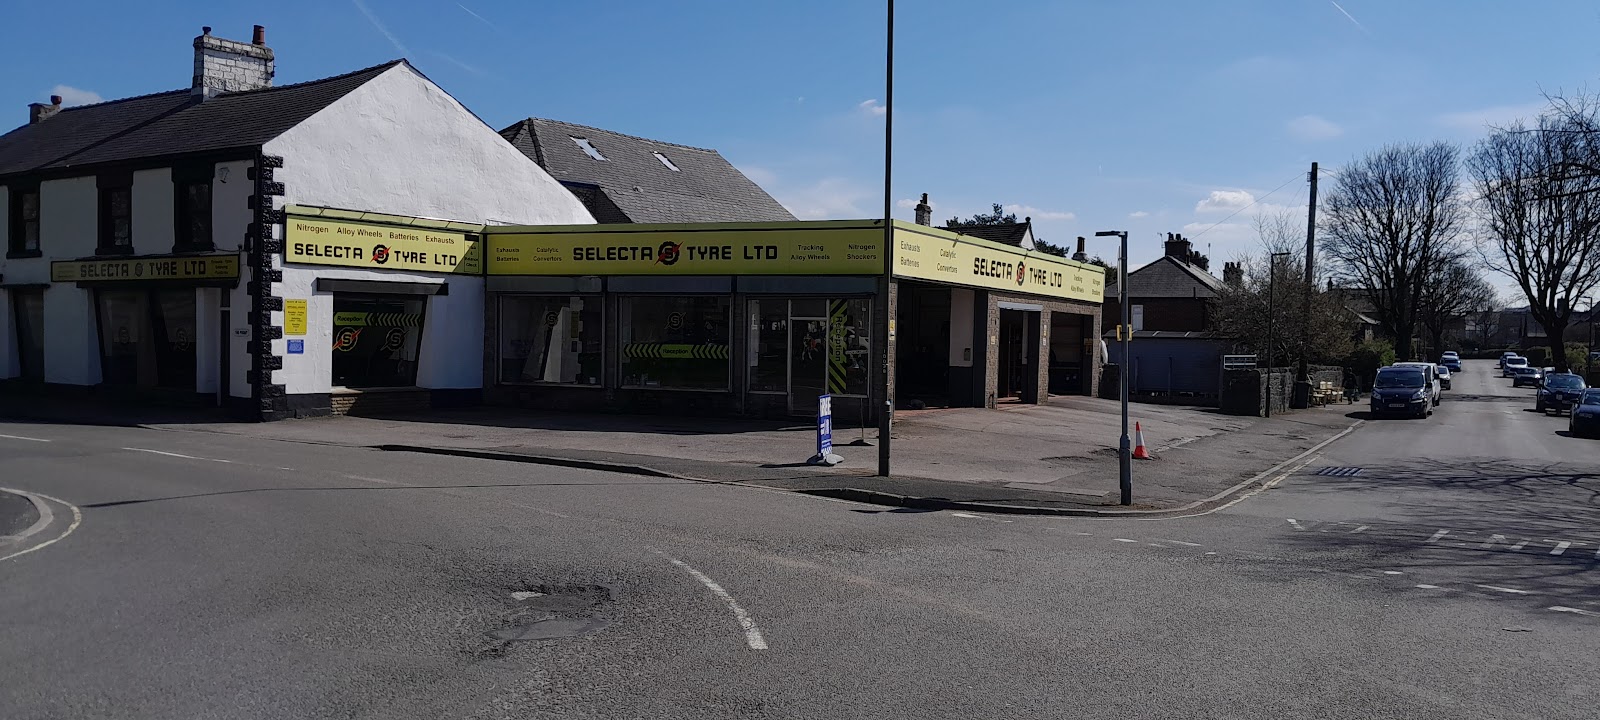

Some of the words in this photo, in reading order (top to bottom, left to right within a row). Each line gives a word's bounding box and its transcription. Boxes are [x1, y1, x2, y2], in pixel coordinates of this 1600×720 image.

[296, 223, 329, 234] Nitrogen
[337, 227, 355, 237] Alloy
[357, 228, 383, 238] Wheels
[389, 231, 419, 242] Batteries
[425, 235, 455, 244] Exhausts
[573, 246, 653, 261] SELECTA
[686, 245, 732, 261] TYRE
[743, 245, 778, 260] LTD
[797, 244, 824, 252] Tracking
[848, 243, 876, 251] Nitrogen
[900, 240, 921, 253] Exhausts
[294, 243, 363, 260] SELECTA
[394, 250, 427, 264] TYRE
[434, 253, 457, 266] LTD
[939, 248, 957, 260] Catalytic
[900, 256, 920, 268] Batteries
[936, 262, 958, 274] Convertors
[80, 264, 129, 278] SELECTA
[149, 261, 177, 276] TYRE
[184, 260, 206, 275] LTD
[973, 257, 1013, 280] SELECTA
[1029, 267, 1047, 286] TYRE
[1049, 271, 1062, 288] LTD
[337, 315, 363, 323] Reception
[834, 316, 843, 362] Reception
